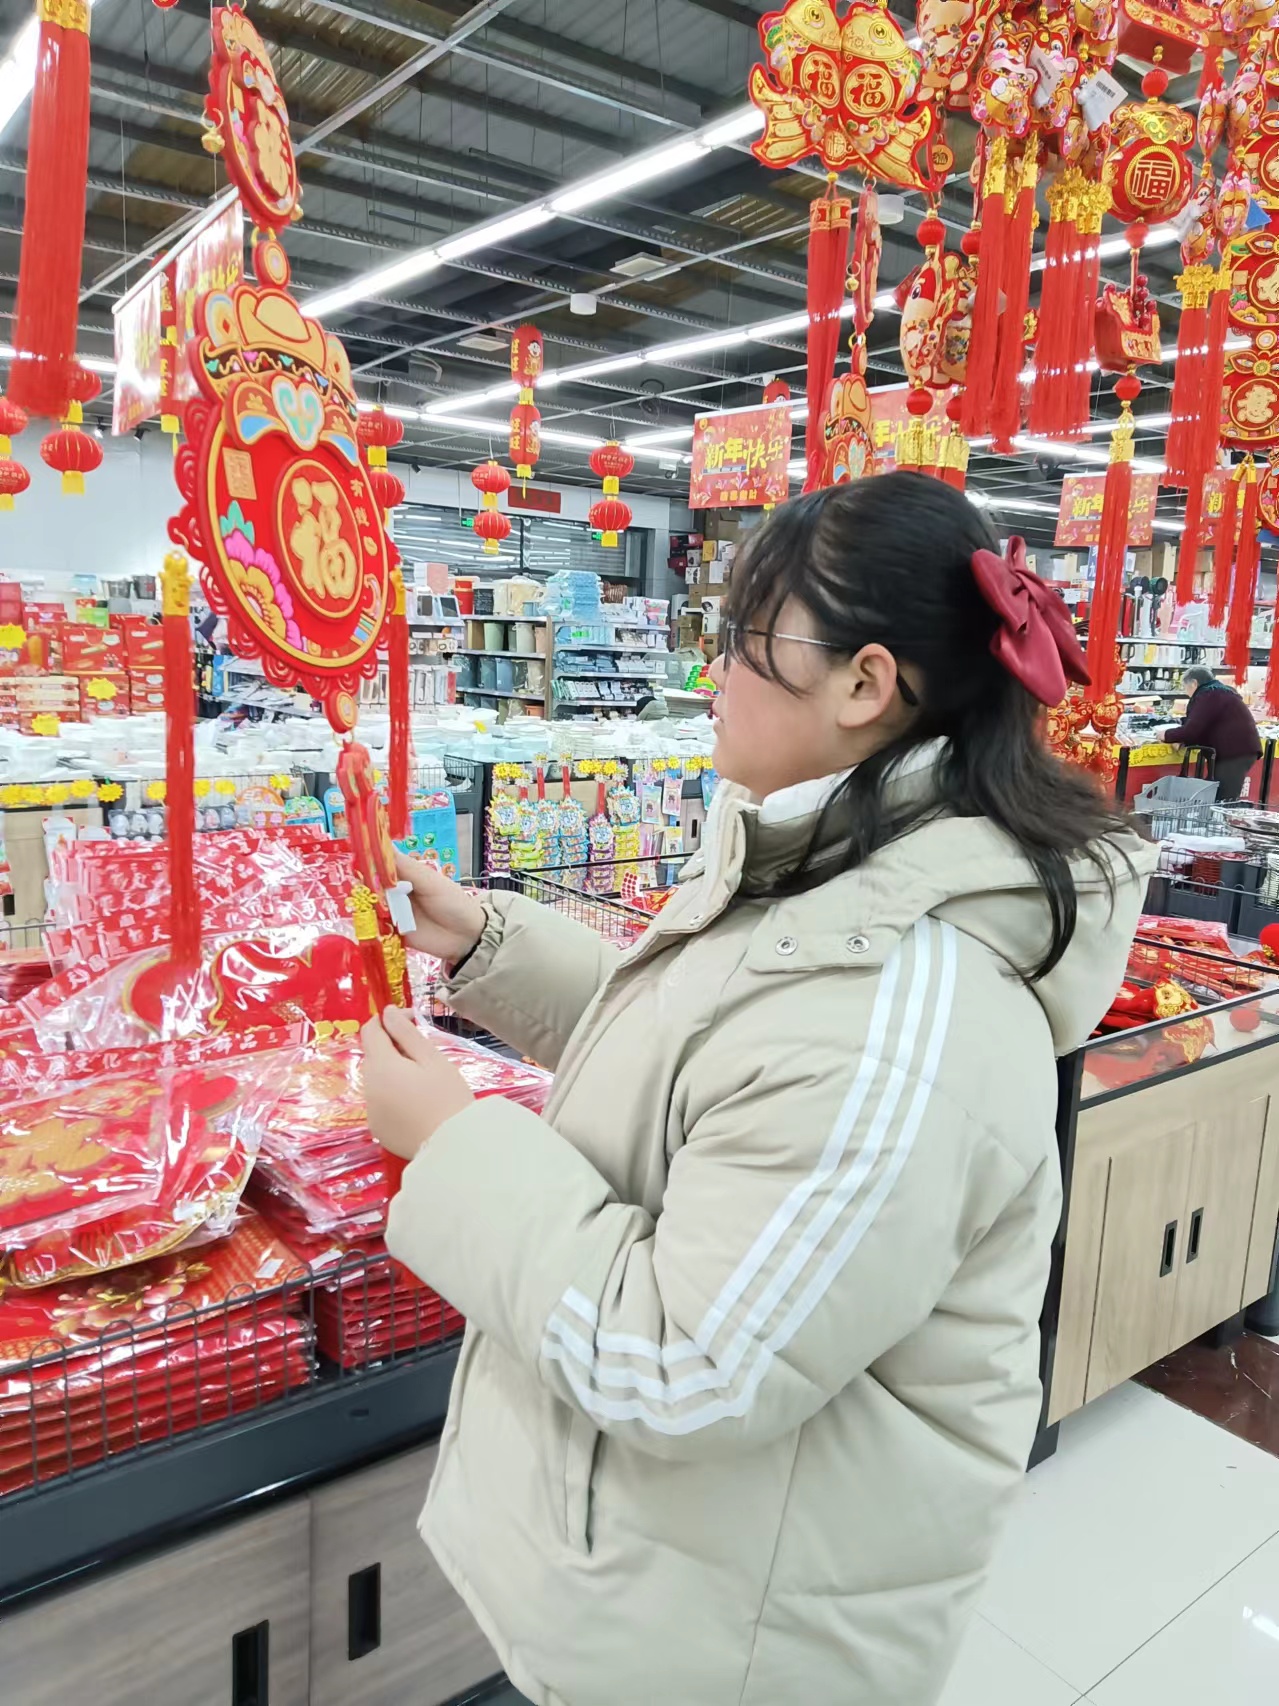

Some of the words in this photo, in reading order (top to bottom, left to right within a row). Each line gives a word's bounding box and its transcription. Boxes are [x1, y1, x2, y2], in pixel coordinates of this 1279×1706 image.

[805, 60, 837, 98] 福
[849, 73, 884, 107] 福
[1132, 159, 1173, 201] 福
[704, 435, 784, 476] 新年快乐
[289, 475, 357, 601] 福
